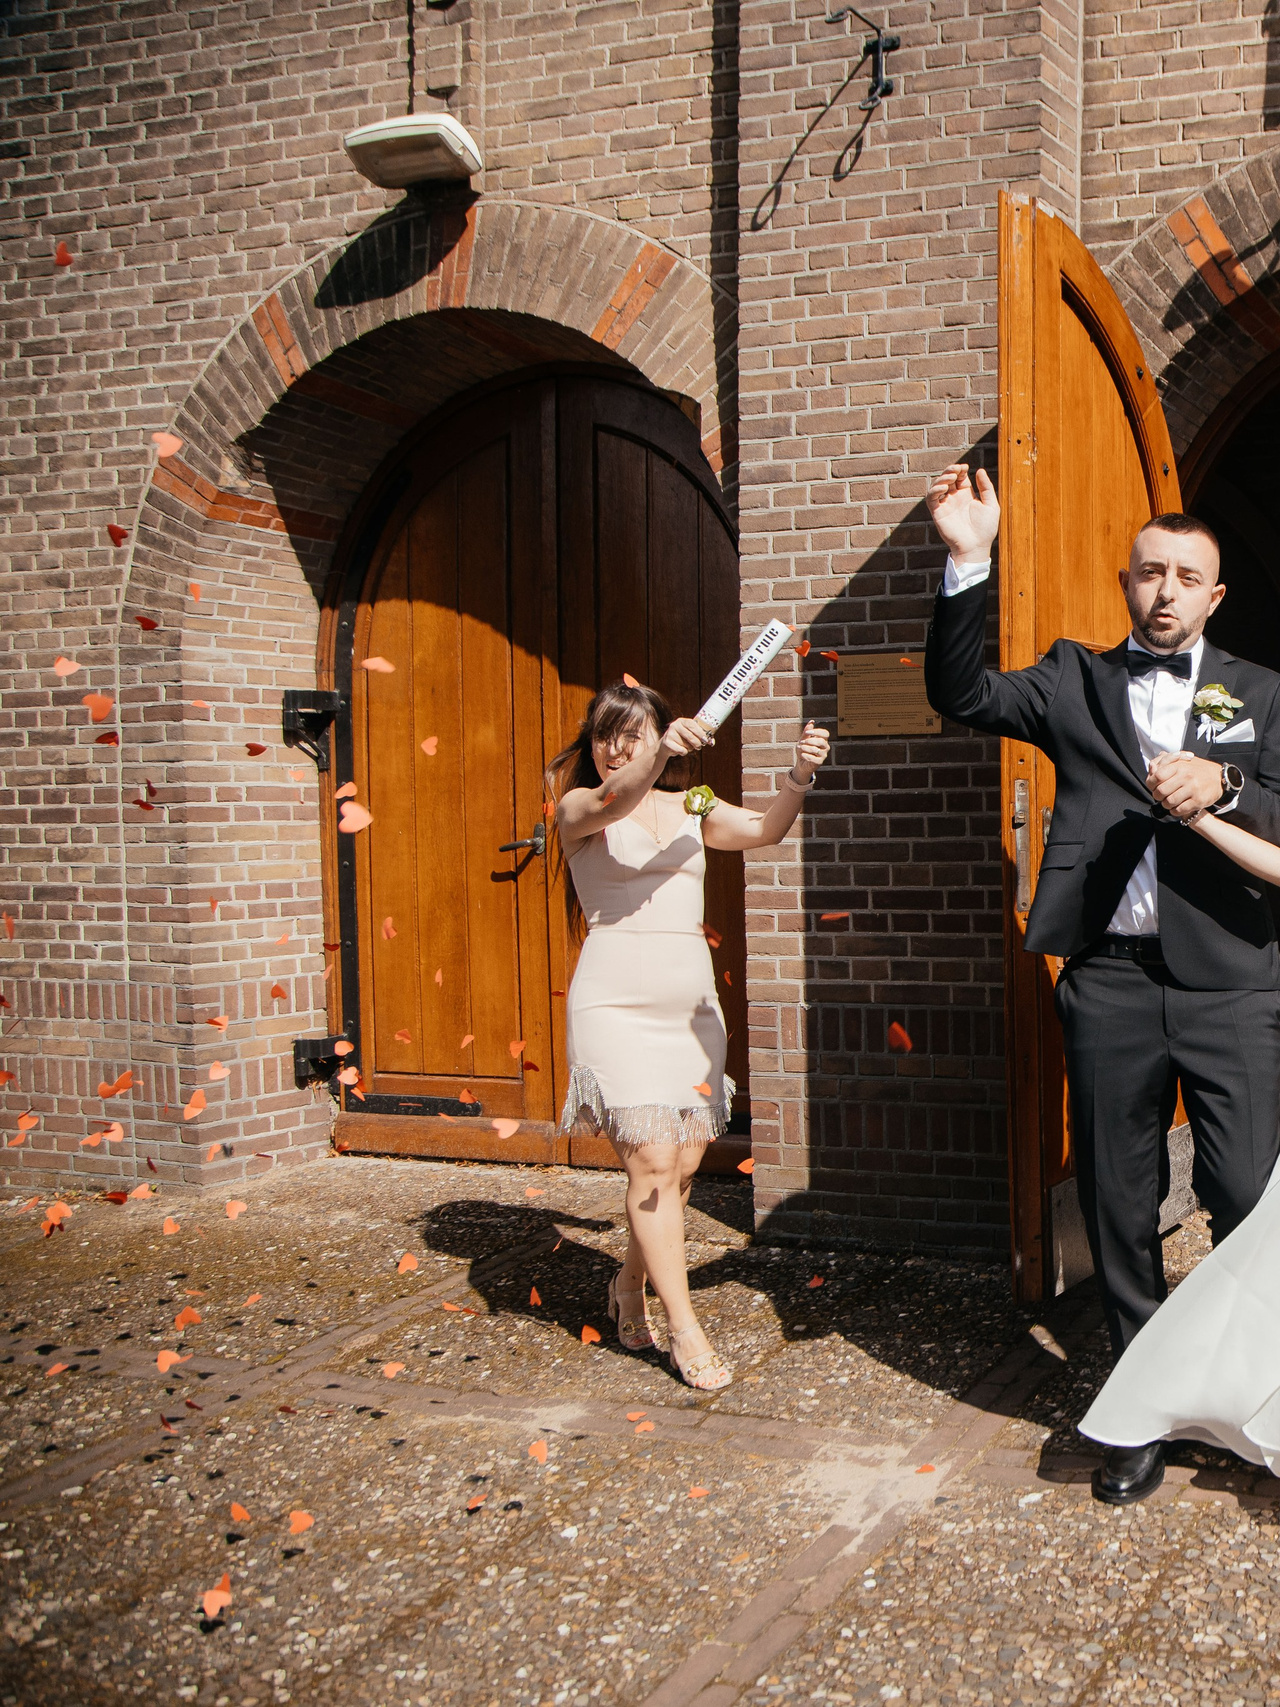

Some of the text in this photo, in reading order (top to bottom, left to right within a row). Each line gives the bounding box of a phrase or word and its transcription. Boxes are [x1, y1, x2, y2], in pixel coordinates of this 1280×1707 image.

[718, 628, 779, 701] let love rule
